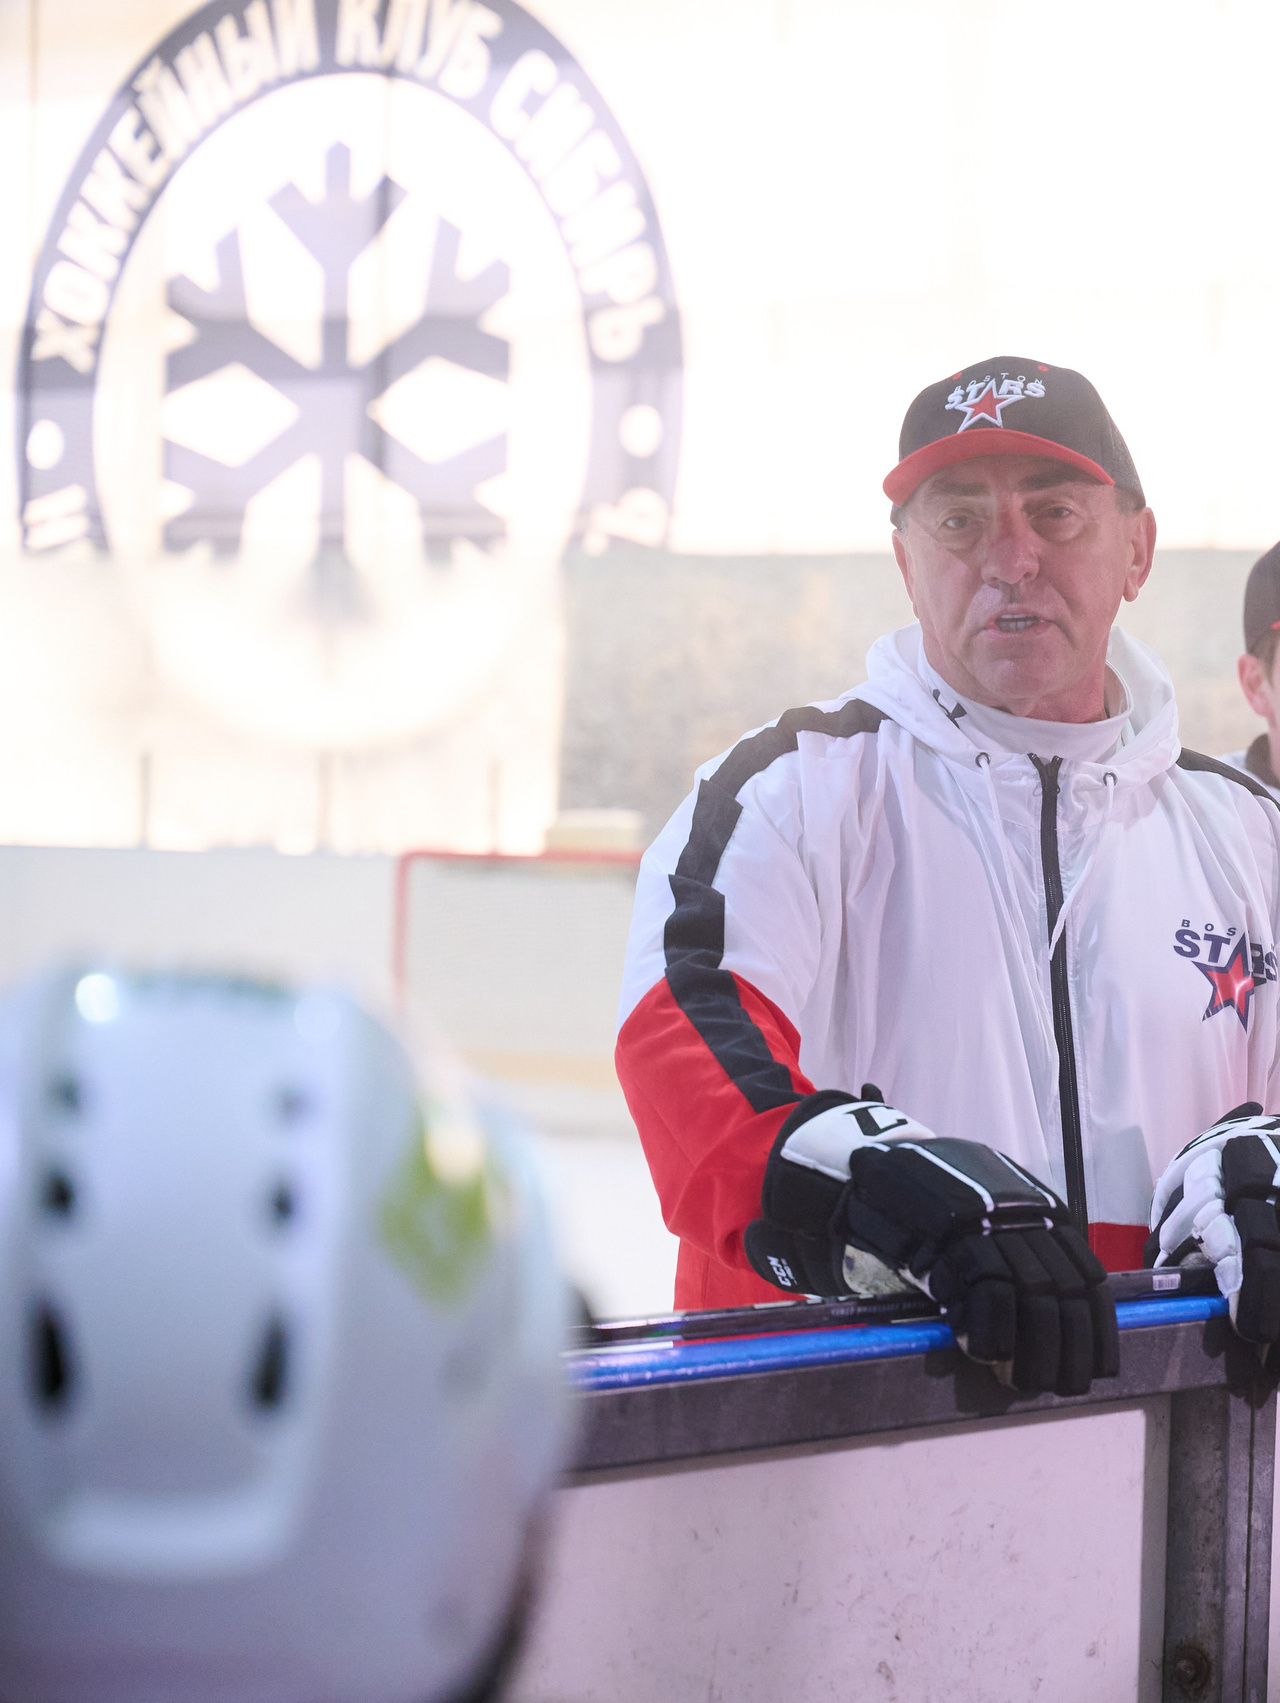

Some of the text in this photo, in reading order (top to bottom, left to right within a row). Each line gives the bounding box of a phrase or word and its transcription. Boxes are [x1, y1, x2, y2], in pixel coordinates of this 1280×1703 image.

[30, 0, 666, 374] ХОККЕЙНЫЙ КЛУБ СИБИРЬ
